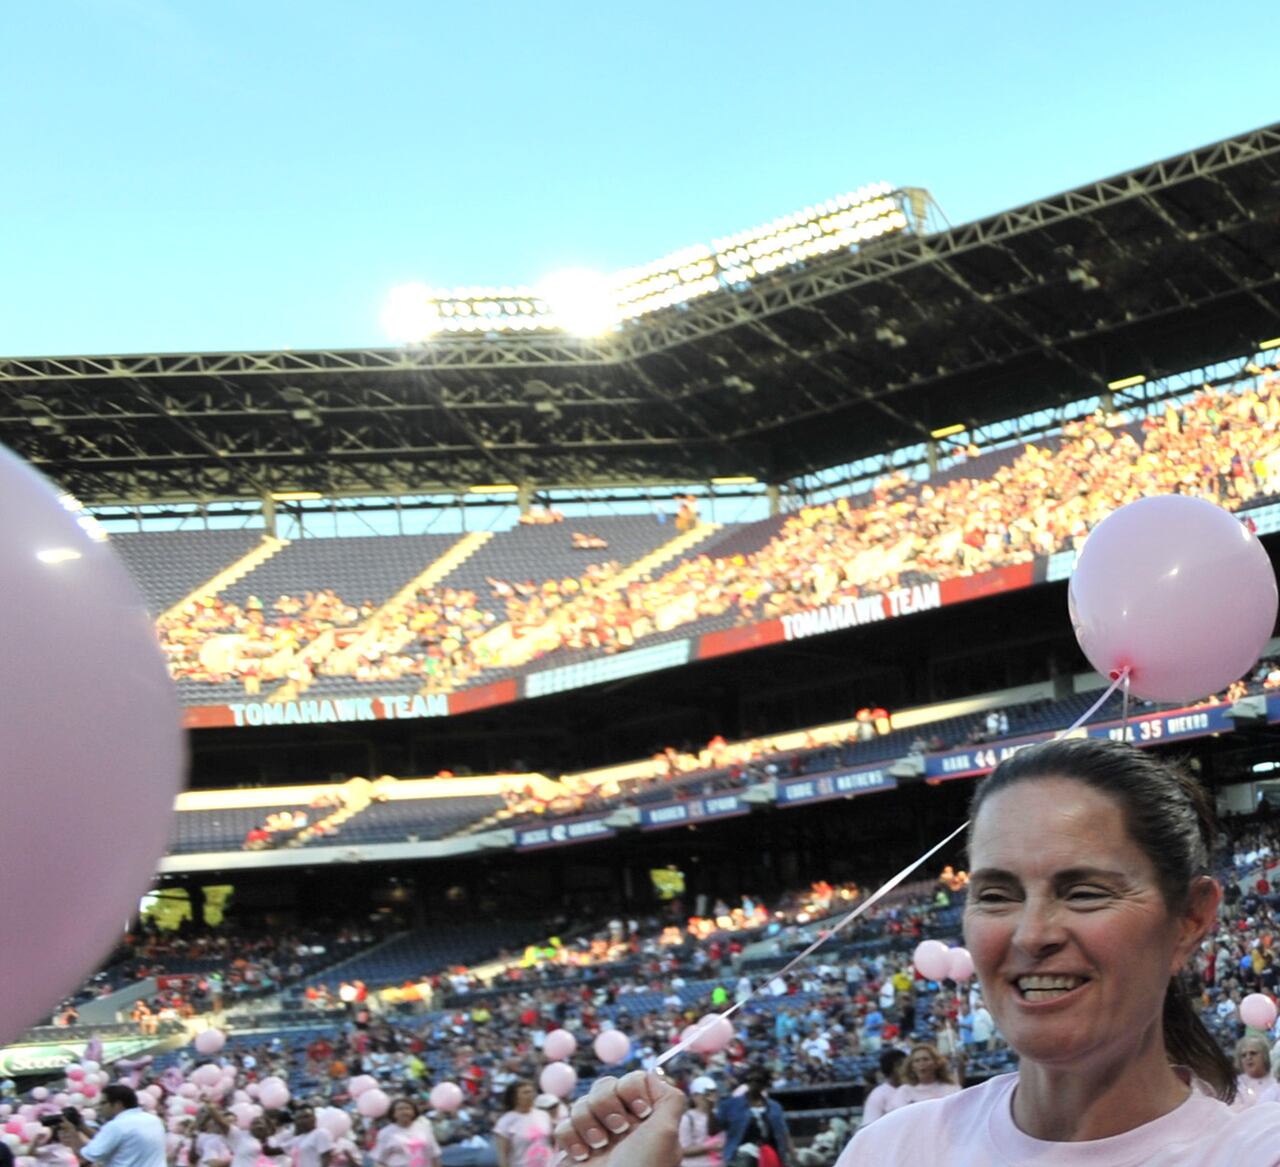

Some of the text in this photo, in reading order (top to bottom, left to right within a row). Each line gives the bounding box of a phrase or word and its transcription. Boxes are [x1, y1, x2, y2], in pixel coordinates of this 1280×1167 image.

[780, 581, 942, 640] TOMAHAWK TEAM
[229, 694, 449, 727] TOMAHAWK TEAM
[1139, 719, 1163, 740] 35
